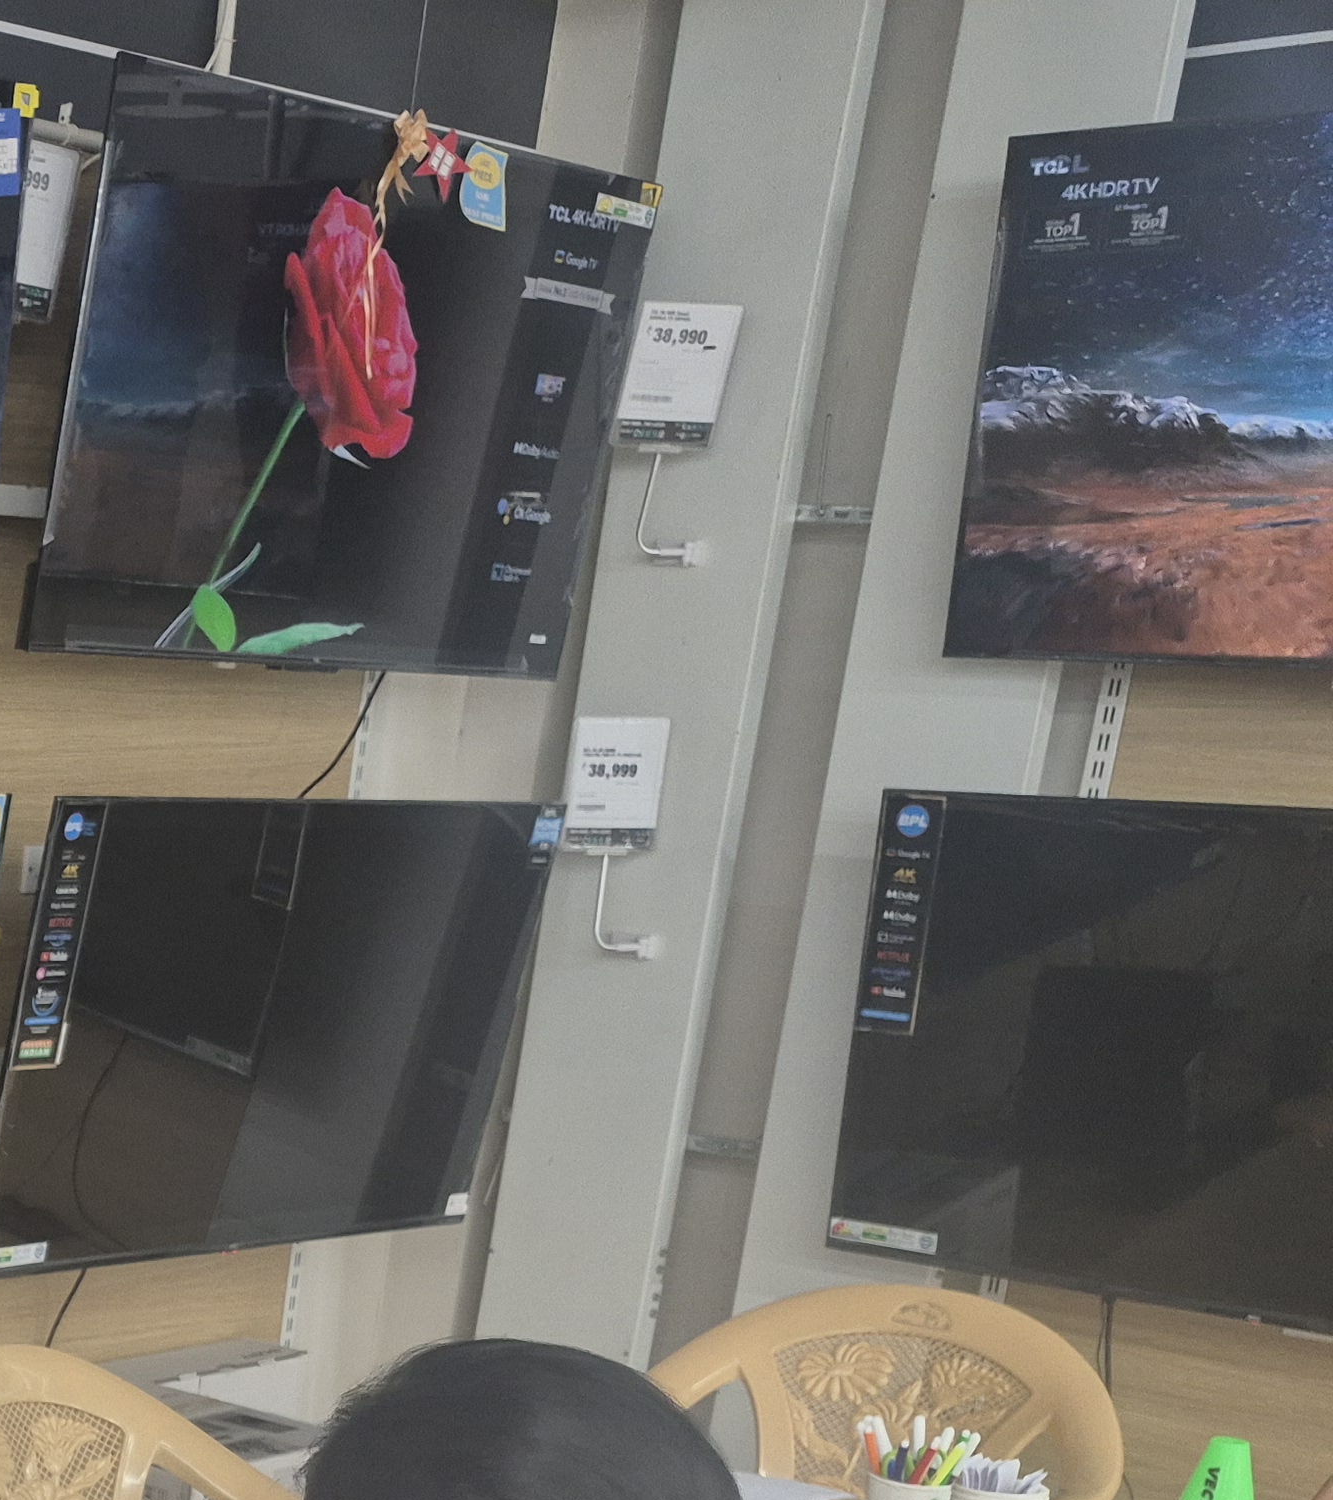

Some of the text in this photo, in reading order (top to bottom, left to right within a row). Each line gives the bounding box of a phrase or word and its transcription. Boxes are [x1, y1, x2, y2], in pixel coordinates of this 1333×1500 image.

[1033, 160, 1069, 176] TCL
[549, 203, 571, 223] TCL
[897, 814, 928, 828] BPL
